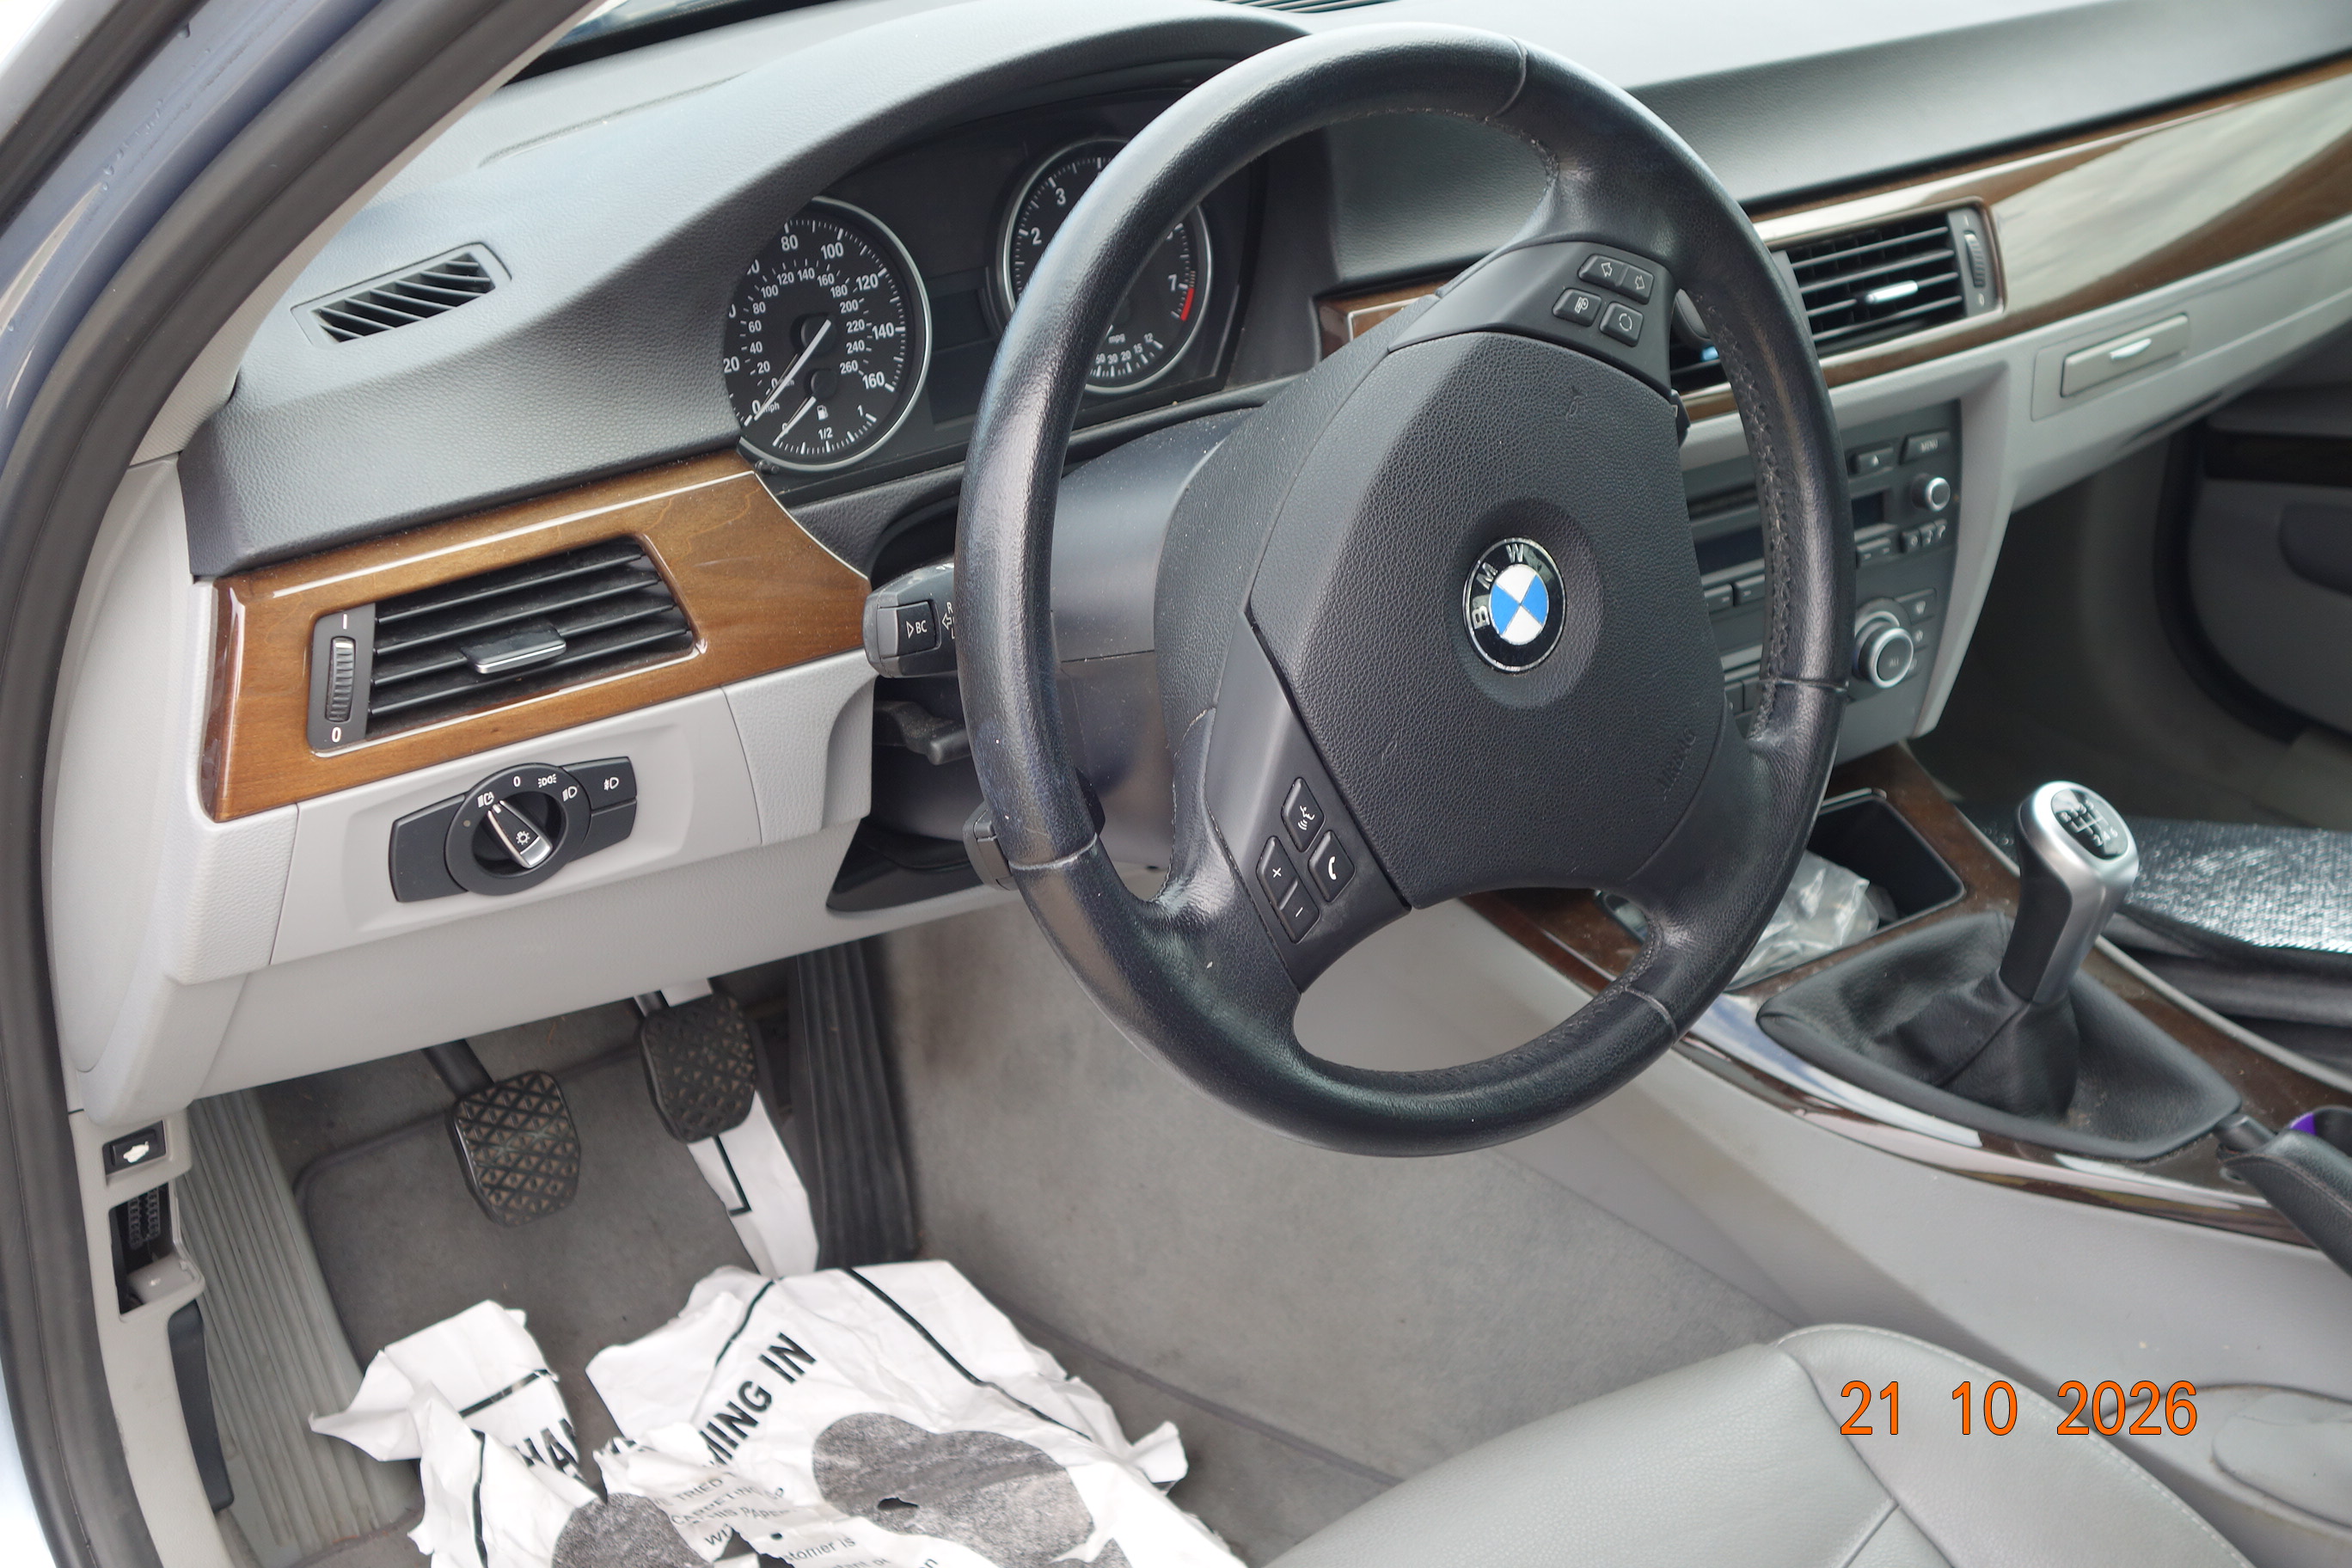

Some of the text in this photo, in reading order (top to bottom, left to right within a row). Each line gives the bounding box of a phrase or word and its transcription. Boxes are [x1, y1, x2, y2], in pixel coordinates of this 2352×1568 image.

[1056, 187, 1066, 205] 3
[781, 234, 799, 251] 80
[1032, 228, 1042, 245] 2
[821, 242, 844, 260] 100
[747, 259, 760, 275] 0
[797, 267, 815, 281] 140
[777, 272, 794, 285] 120
[817, 273, 835, 287] 160
[855, 273, 879, 291] 120
[1168, 273, 1177, 291] 7
[761, 285, 779, 297] 100
[830, 285, 848, 298] 180
[752, 301, 766, 315] 80
[839, 299, 859, 314] 200
[748, 320, 762, 333] 60
[846, 319, 866, 333] 220
[872, 322, 895, 340] 140
[1108, 333, 1125, 344] mpg
[750, 341, 763, 354] 40
[846, 340, 866, 354] 240
[1121, 350, 1131, 361] 20
[1143, 333, 1153, 343] 12
[723, 356, 740, 373] 20
[756, 360, 770, 374] 20
[839, 359, 859, 375] 260
[862, 371, 885, 389] 160
[818, 426, 833, 440] 1/2
[1471, 542, 1525, 630] BMW
[946, 602, 953, 614] R
[915, 620, 928, 634] BC
[758, 1332, 817, 1384] IN
[839, 1536, 855, 1548] is
